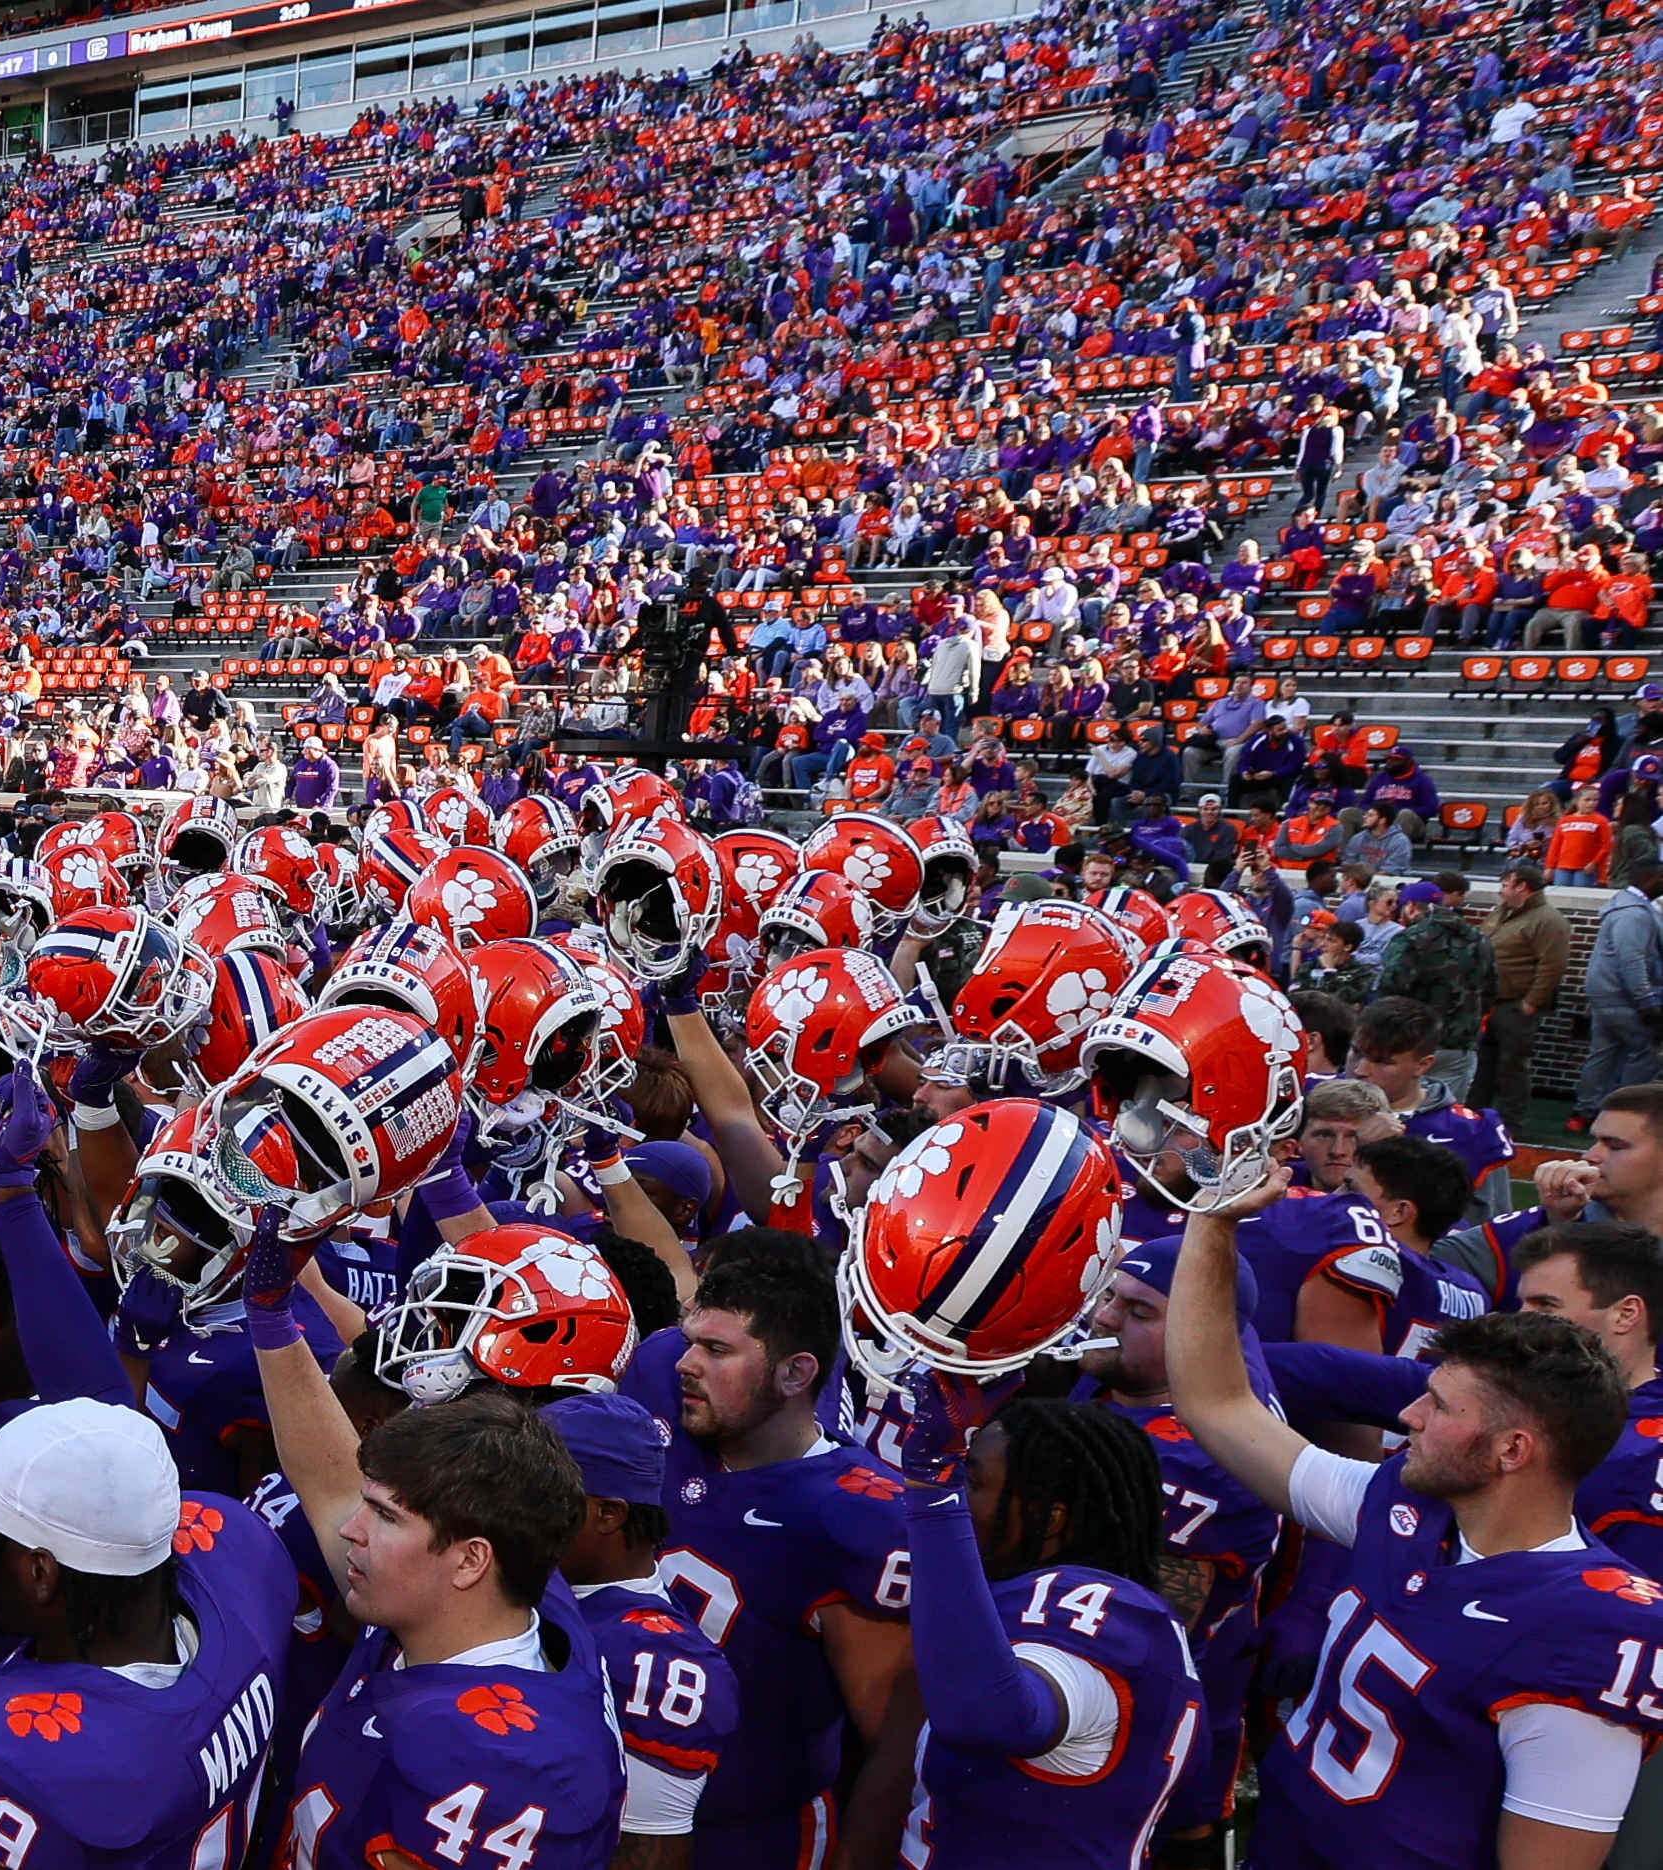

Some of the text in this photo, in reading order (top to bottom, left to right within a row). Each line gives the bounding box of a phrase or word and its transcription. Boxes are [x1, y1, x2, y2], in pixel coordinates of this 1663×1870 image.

[48, 51, 58, 66] 0
[130, 3, 310, 53] Brigham Young 3:30
[1163, 1484, 1219, 1545] 7
[1021, 1571, 1114, 1637] 14
[625, 1651, 707, 1728] 18
[1286, 1590, 1432, 1801] 15
[199, 1671, 275, 1810] MAYO
[426, 1782, 545, 1868] 44
